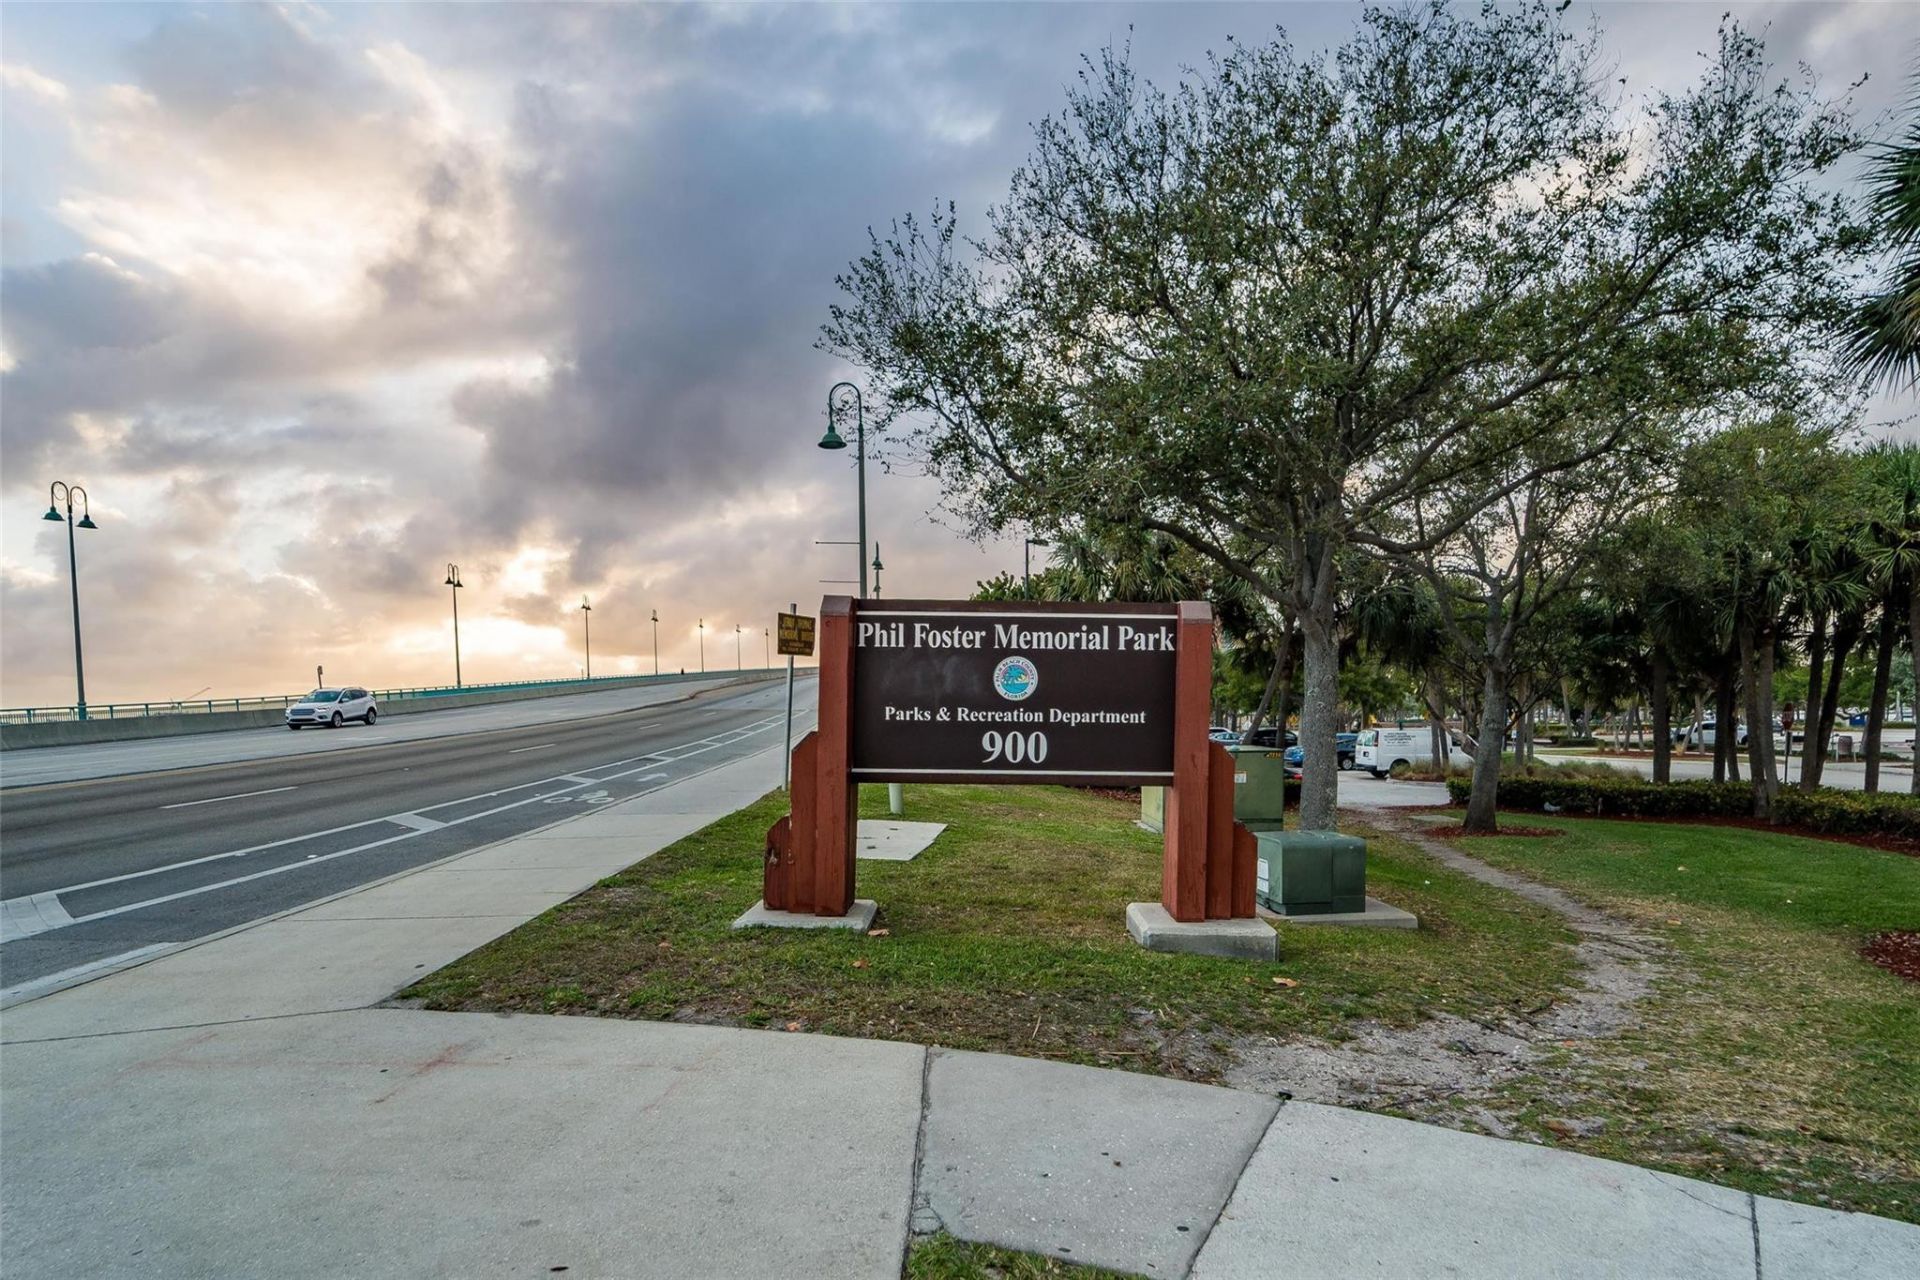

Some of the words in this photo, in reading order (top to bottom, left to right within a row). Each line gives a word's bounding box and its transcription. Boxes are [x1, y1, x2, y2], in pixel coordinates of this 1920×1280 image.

[857, 622, 905, 648] Phil
[913, 623, 986, 648] Foster
[994, 624, 1110, 651] Memorial
[1117, 625, 1175, 651] Park
[1004, 691, 1028, 699] FLORIDA
[884, 706, 932, 721] Parks
[936, 707, 951, 722] &
[957, 707, 1044, 723] Recreation
[1049, 708, 1147, 727] Department
[981, 730, 1048, 764] 900
